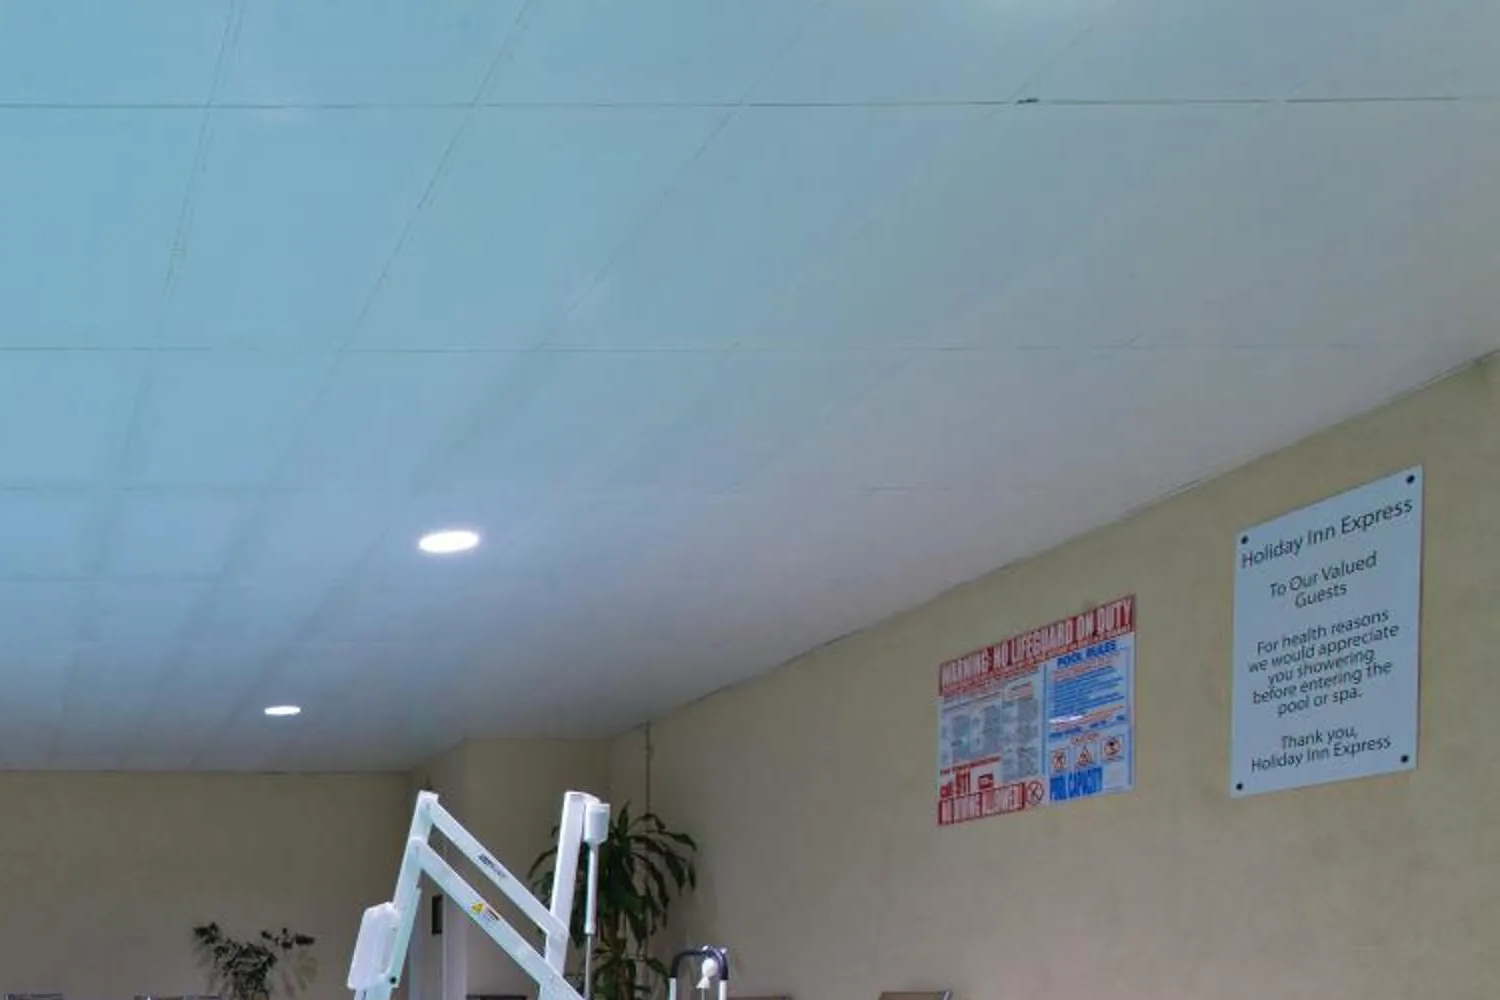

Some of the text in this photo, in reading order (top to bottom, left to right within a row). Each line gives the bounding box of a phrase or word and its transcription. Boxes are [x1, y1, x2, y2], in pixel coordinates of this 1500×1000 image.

[1241, 499, 1413, 568] Holiday Inn Express
[1269, 550, 1377, 598] To Our Valued
[1295, 583, 1347, 608] Guests
[1248, 624, 1399, 673] we would appreciate
[1257, 610, 1389, 655] For health reasons
[1253, 661, 1393, 705] before entering the
[1268, 649, 1375, 688] you showering
[1277, 687, 1363, 718] pool or spa.
[1251, 735, 1392, 772] Holiday Inn Express
[1281, 726, 1358, 750] Thank you,
